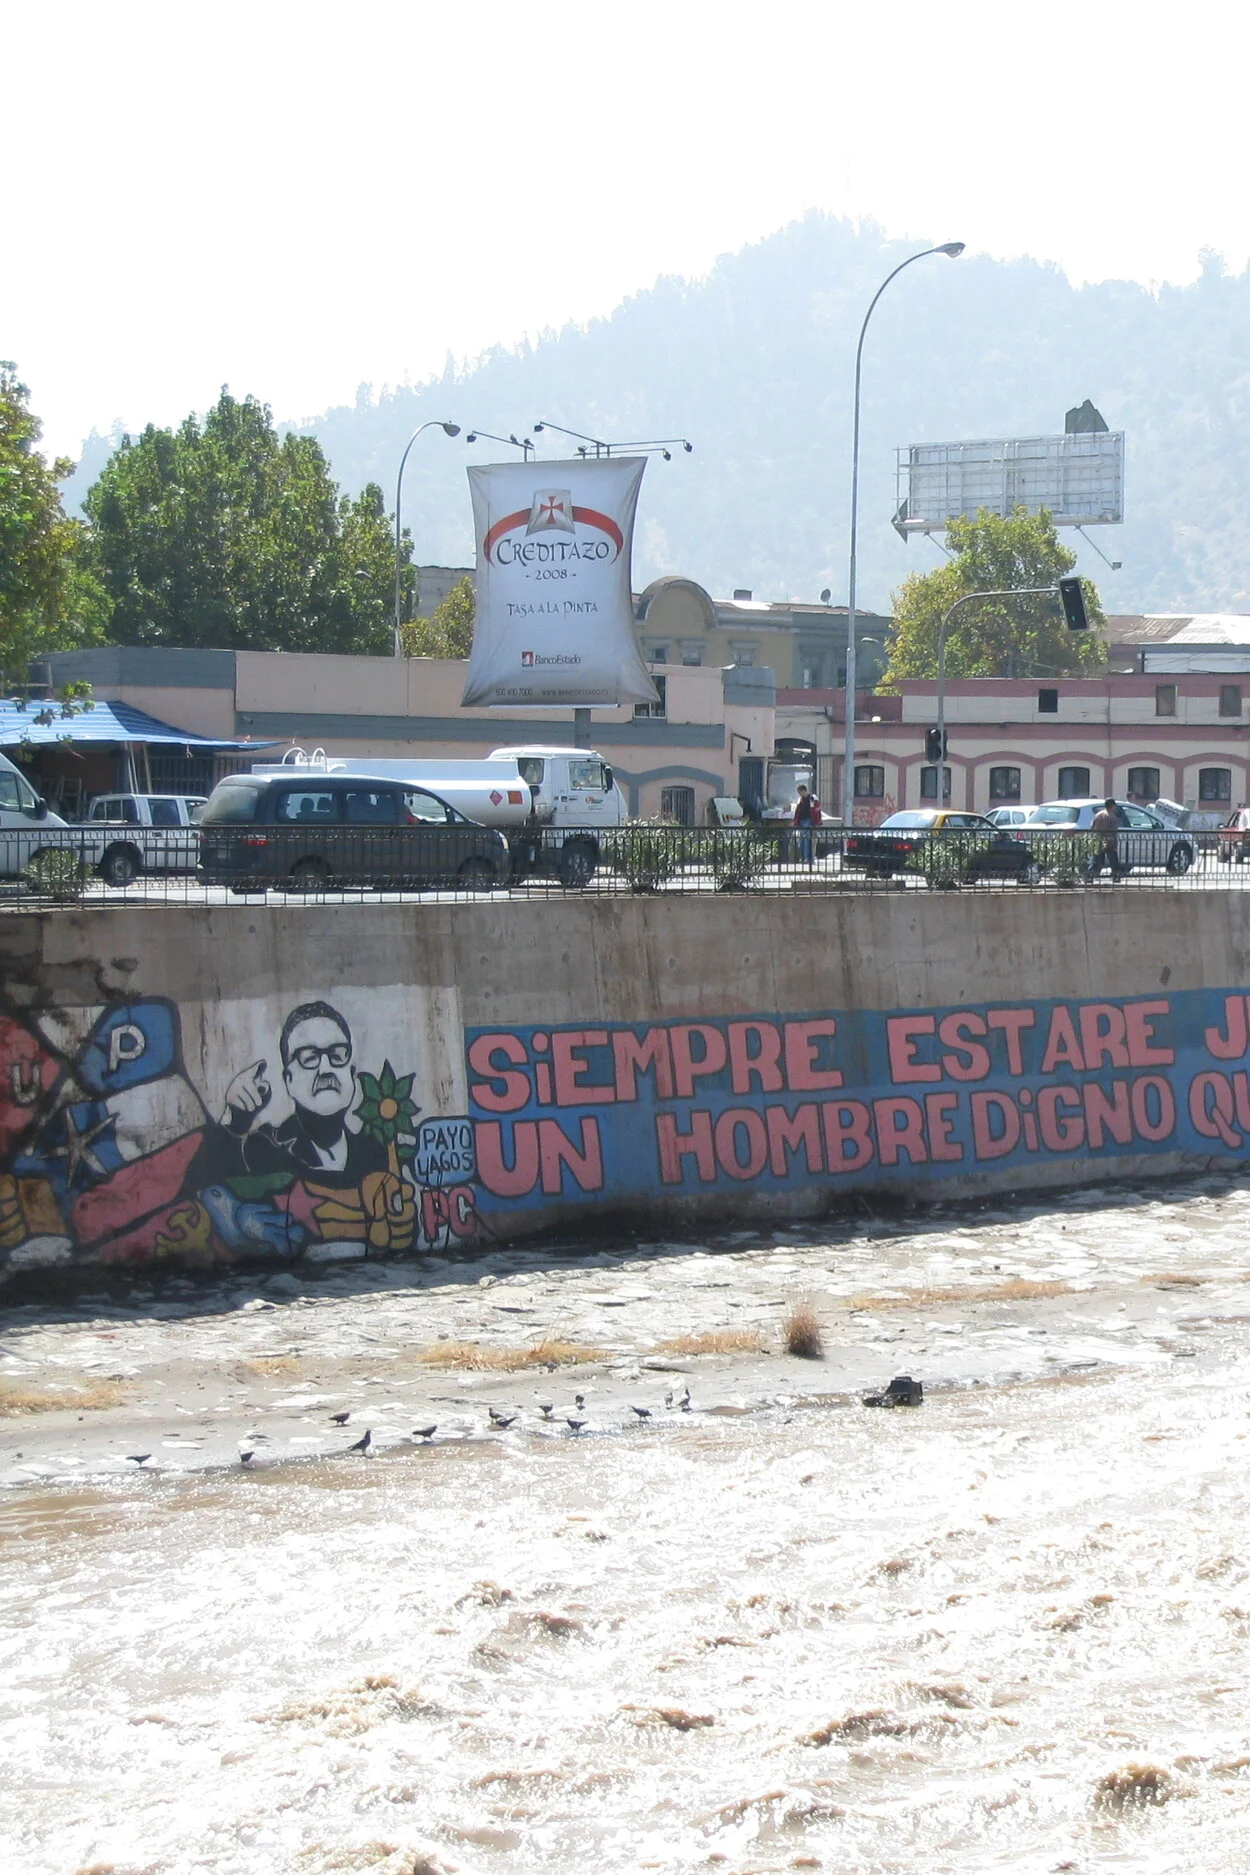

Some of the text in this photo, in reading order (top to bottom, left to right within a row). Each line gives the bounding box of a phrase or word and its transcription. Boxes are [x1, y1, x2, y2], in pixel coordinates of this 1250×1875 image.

[496, 538, 610, 567] CREDITAZO
[535, 569, 568, 580] 2008
[507, 603, 534, 618] TASA
[563, 601, 598, 619] PINTA
[534, 654, 581, 665] BancoEstado
[109, 1024, 145, 1072] P
[886, 1000, 1175, 1085] ESTARE
[423, 1125, 472, 1151] PAYO
[475, 1115, 604, 1198] UN
[655, 1092, 964, 1185] HOMBRE
